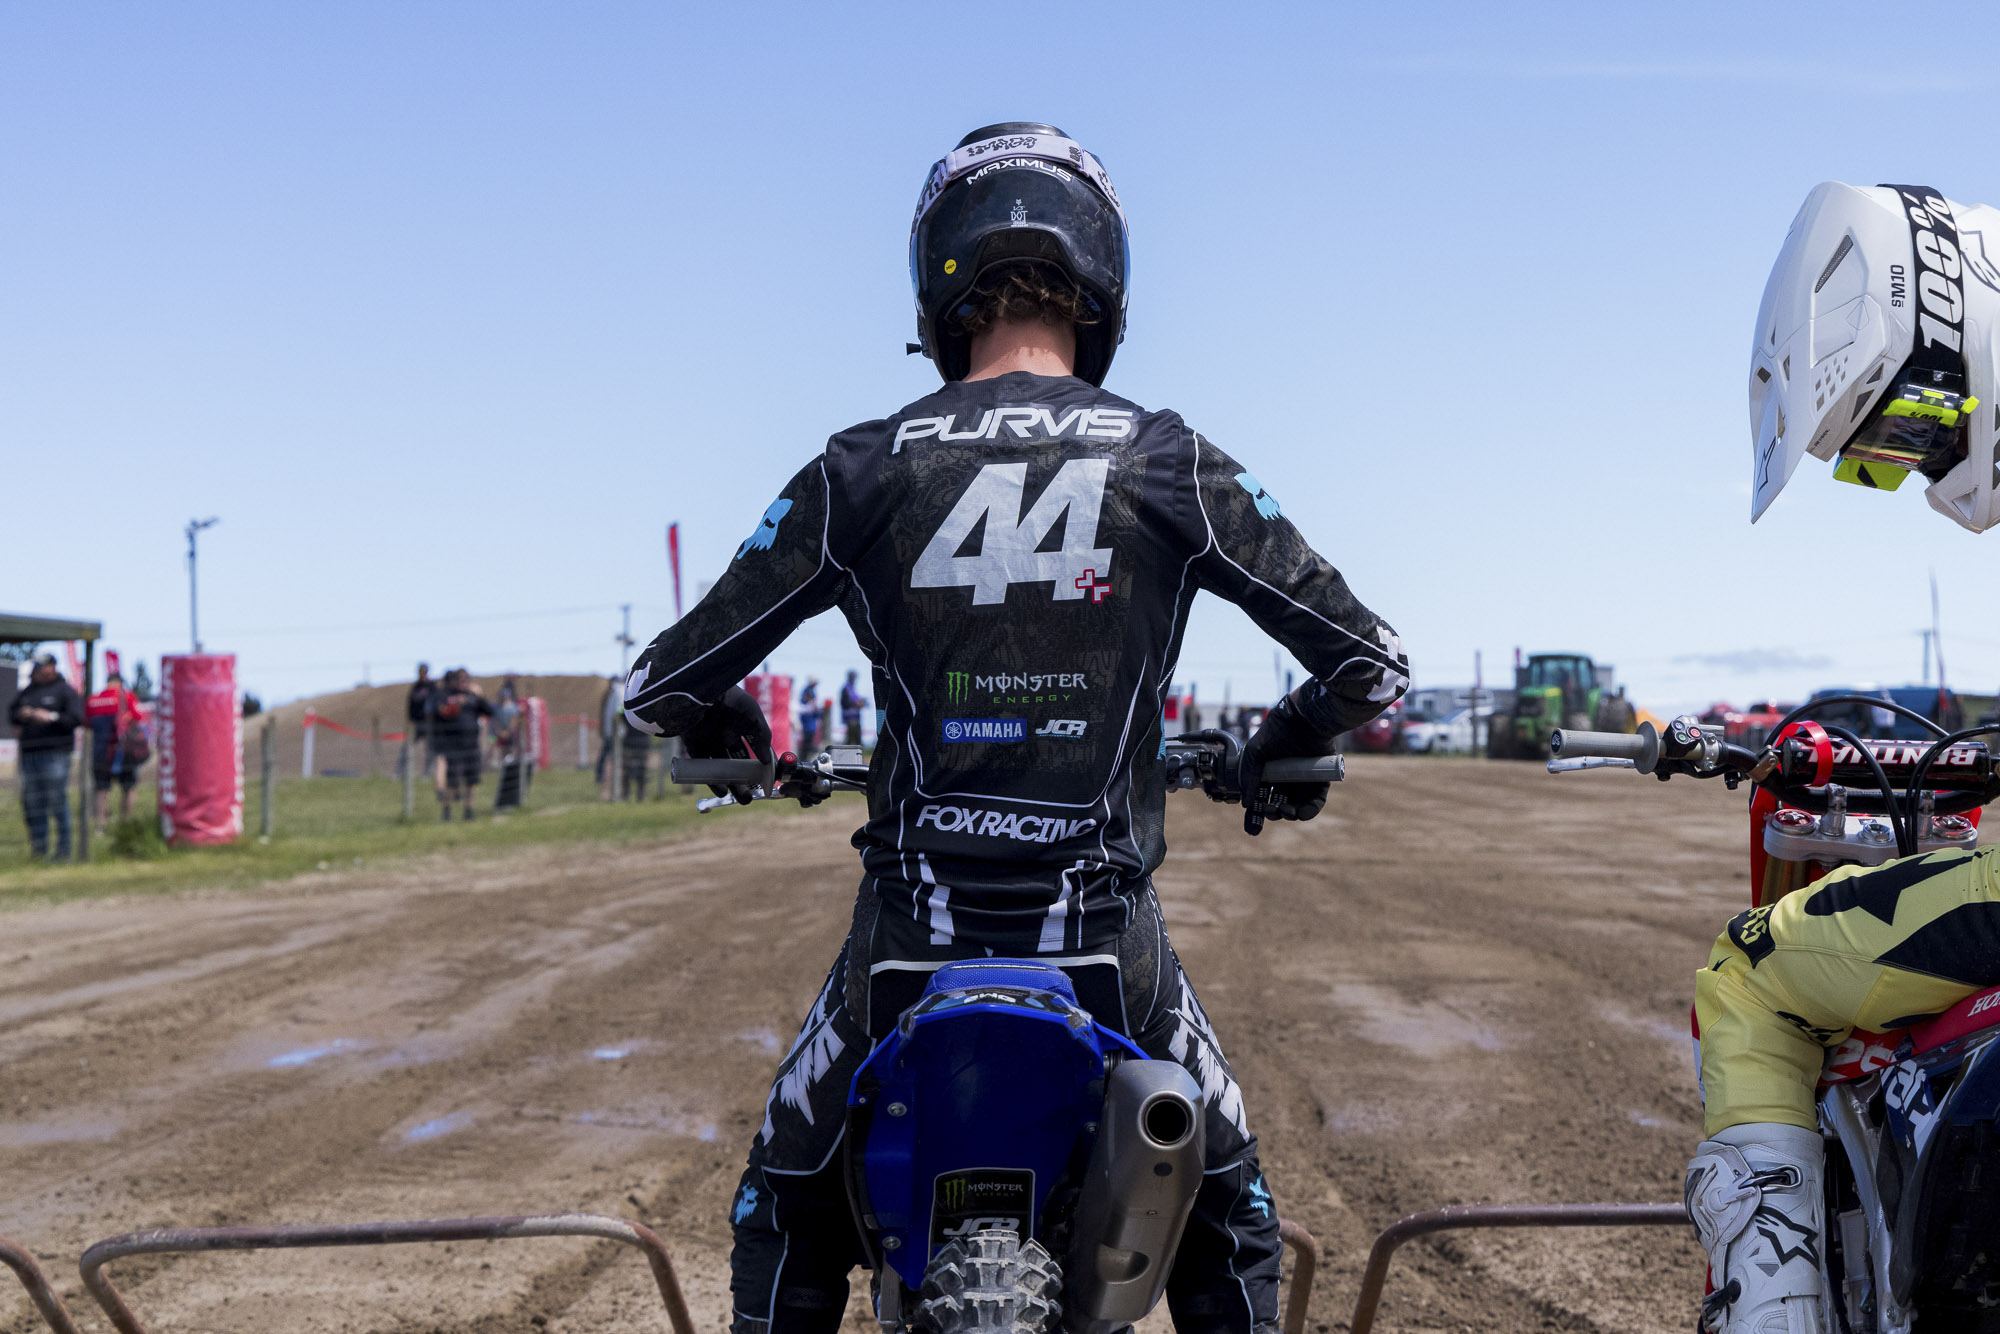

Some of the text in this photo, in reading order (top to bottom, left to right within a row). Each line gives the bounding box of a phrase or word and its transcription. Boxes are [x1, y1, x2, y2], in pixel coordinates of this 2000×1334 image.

[966, 158, 1072, 186] MAXIMUS
[1010, 211, 1028, 223] DOT
[1902, 192, 1964, 353] 100%
[892, 407, 1133, 455] PURVIS
[910, 458, 1114, 606] 44
[975, 672, 1089, 694] MONSTER
[993, 694, 1072, 704] ENERGY
[963, 722, 1023, 738] YAMAHA
[1035, 719, 1088, 736] JCR
[916, 804, 1097, 844] FOX RACING
[967, 1182, 1024, 1192] MONSTER
